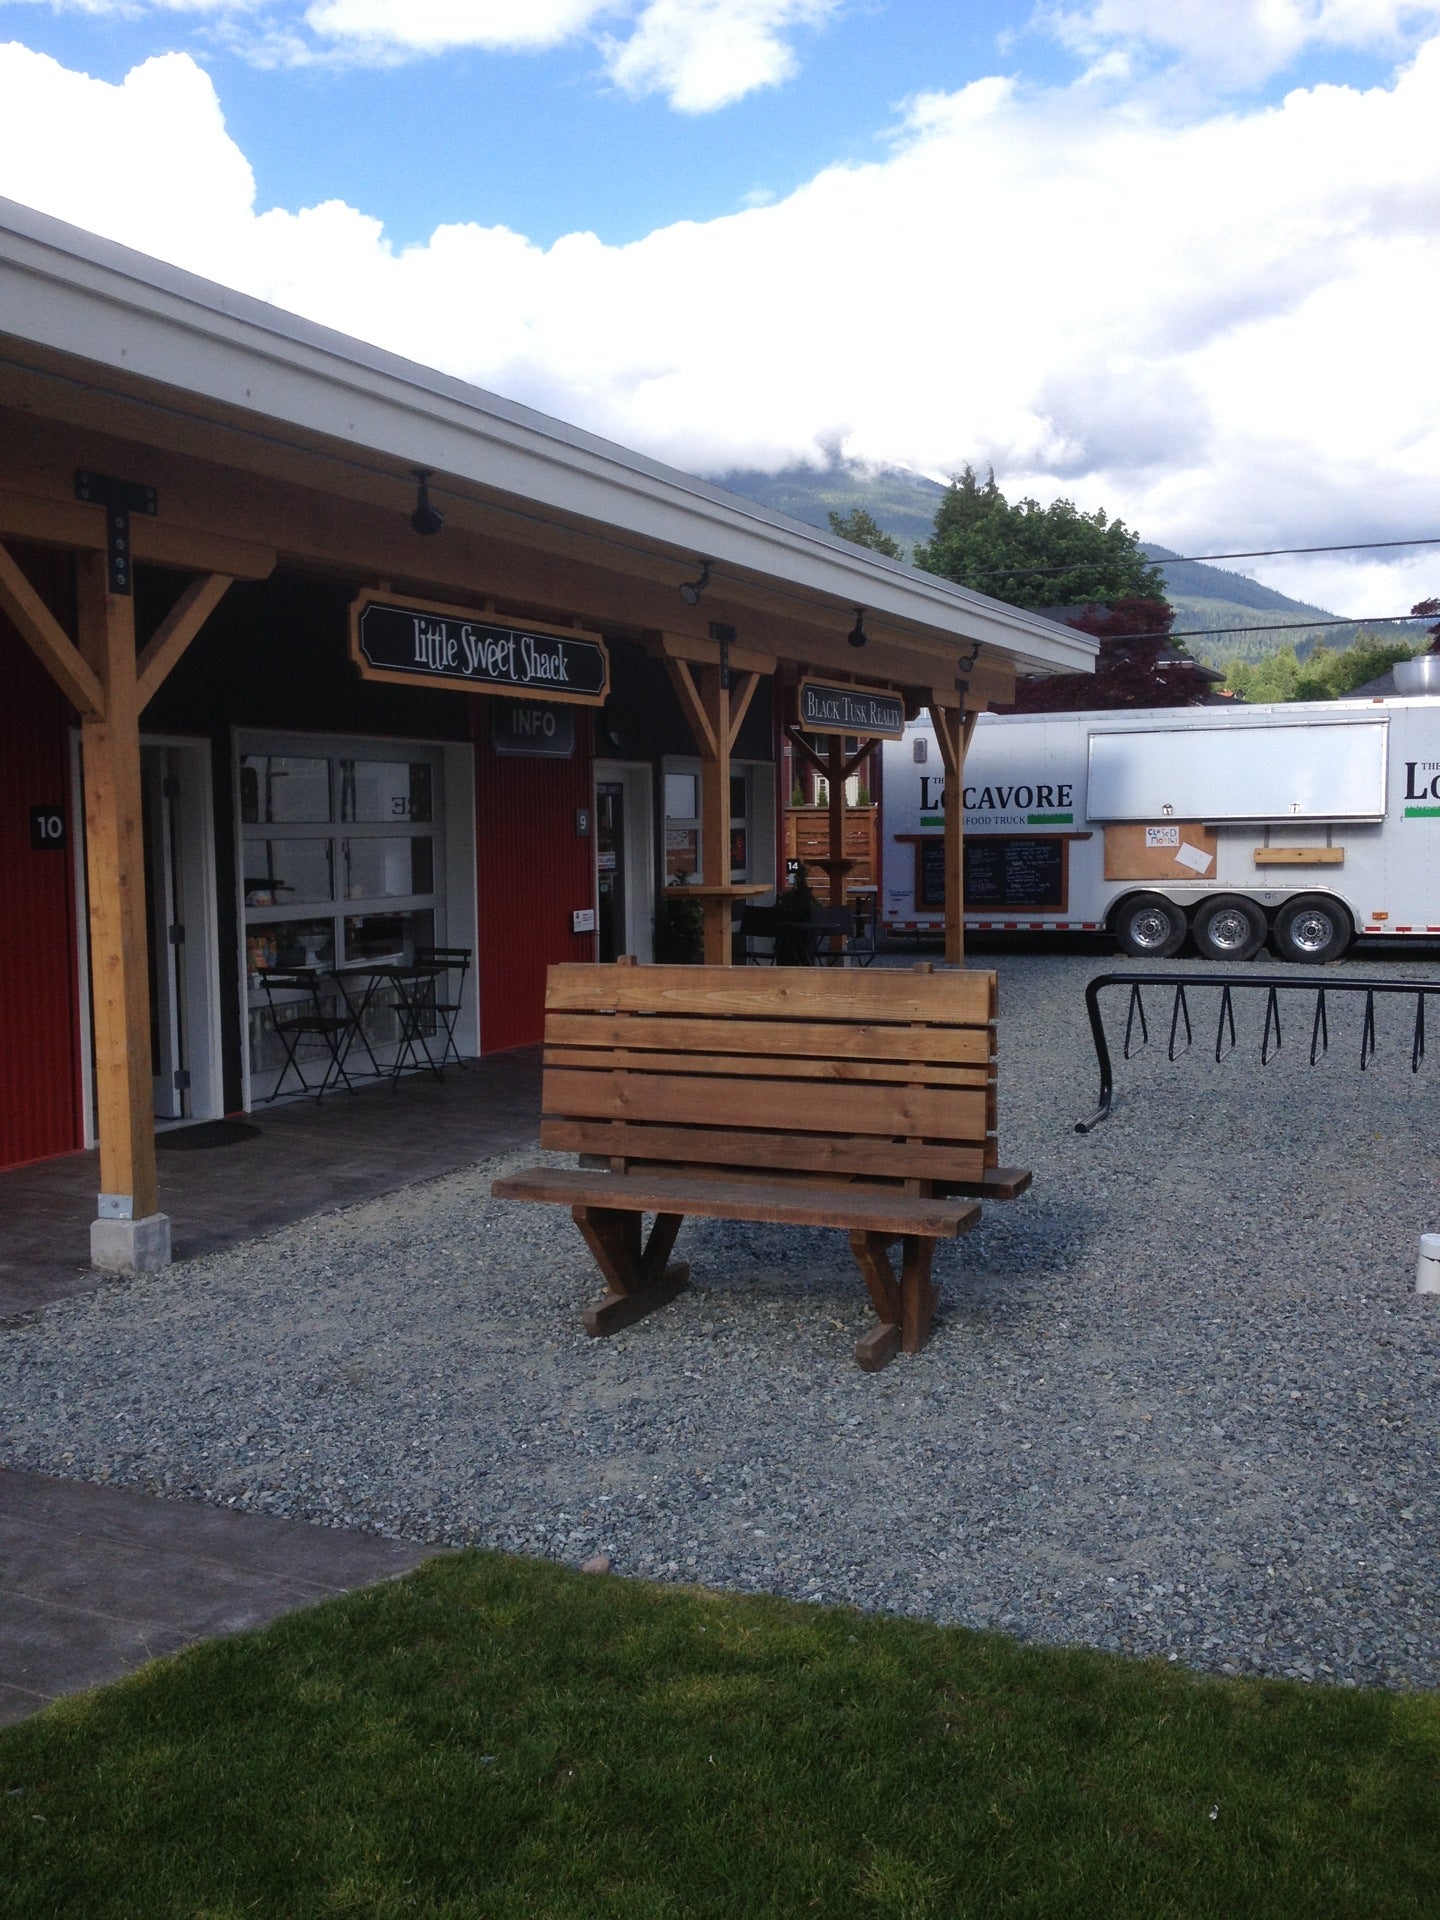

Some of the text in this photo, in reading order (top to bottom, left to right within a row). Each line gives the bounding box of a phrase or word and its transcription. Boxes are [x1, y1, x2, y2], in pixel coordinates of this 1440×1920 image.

[461, 625, 518, 680] Sweet
[521, 637, 569, 682] Shack
[807, 691, 901, 727] BLACK TUSK REALTY
[512, 708, 556, 737] INFO
[919, 776, 1073, 811] LCAVORE
[37, 815, 63, 839] 10
[580, 815, 587, 830] 9
[965, 816, 1026, 825] FOOD TRUCK
[787, 861, 799, 871] 14
